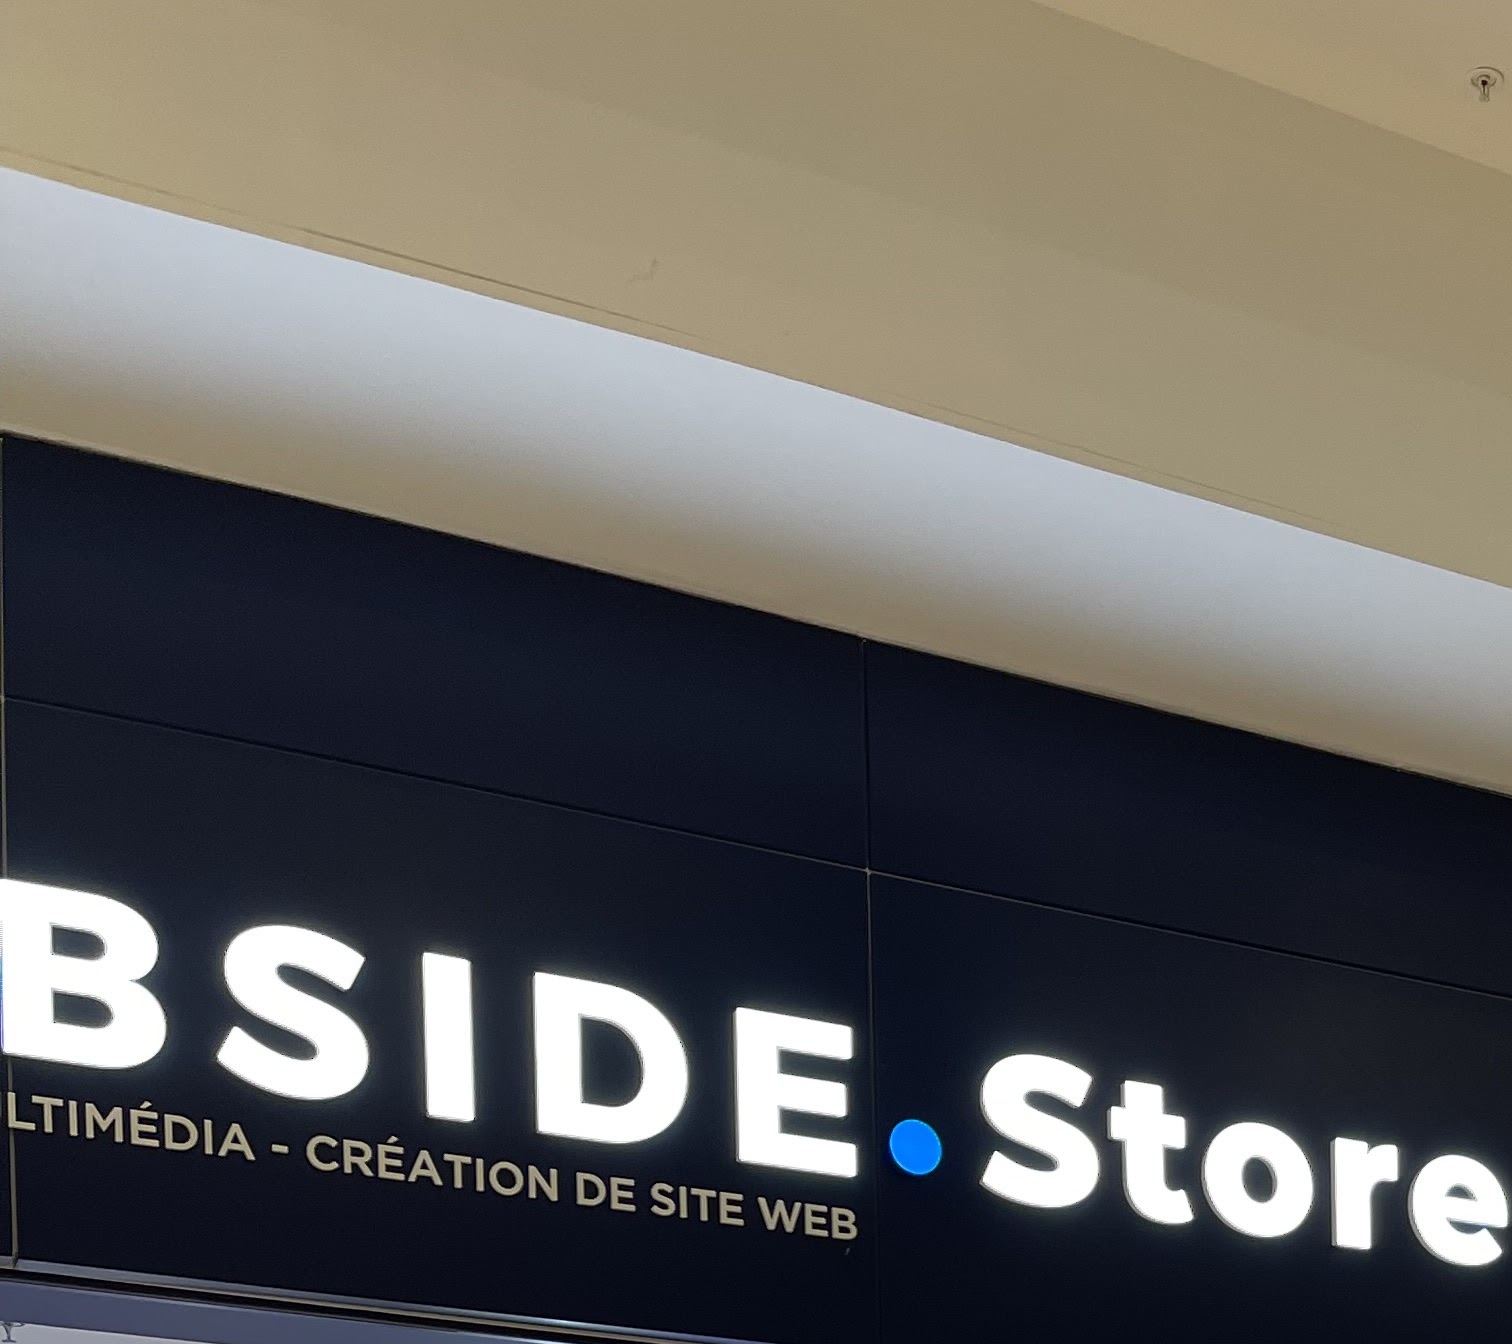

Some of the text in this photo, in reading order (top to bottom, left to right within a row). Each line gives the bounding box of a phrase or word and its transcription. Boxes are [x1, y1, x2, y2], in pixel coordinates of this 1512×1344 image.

[306, 1135, 559, 1202] CRÉATION
[576, 1172, 636, 1213] DE
[650, 1182, 745, 1226] SITE
[757, 1197, 859, 1241] WEB
